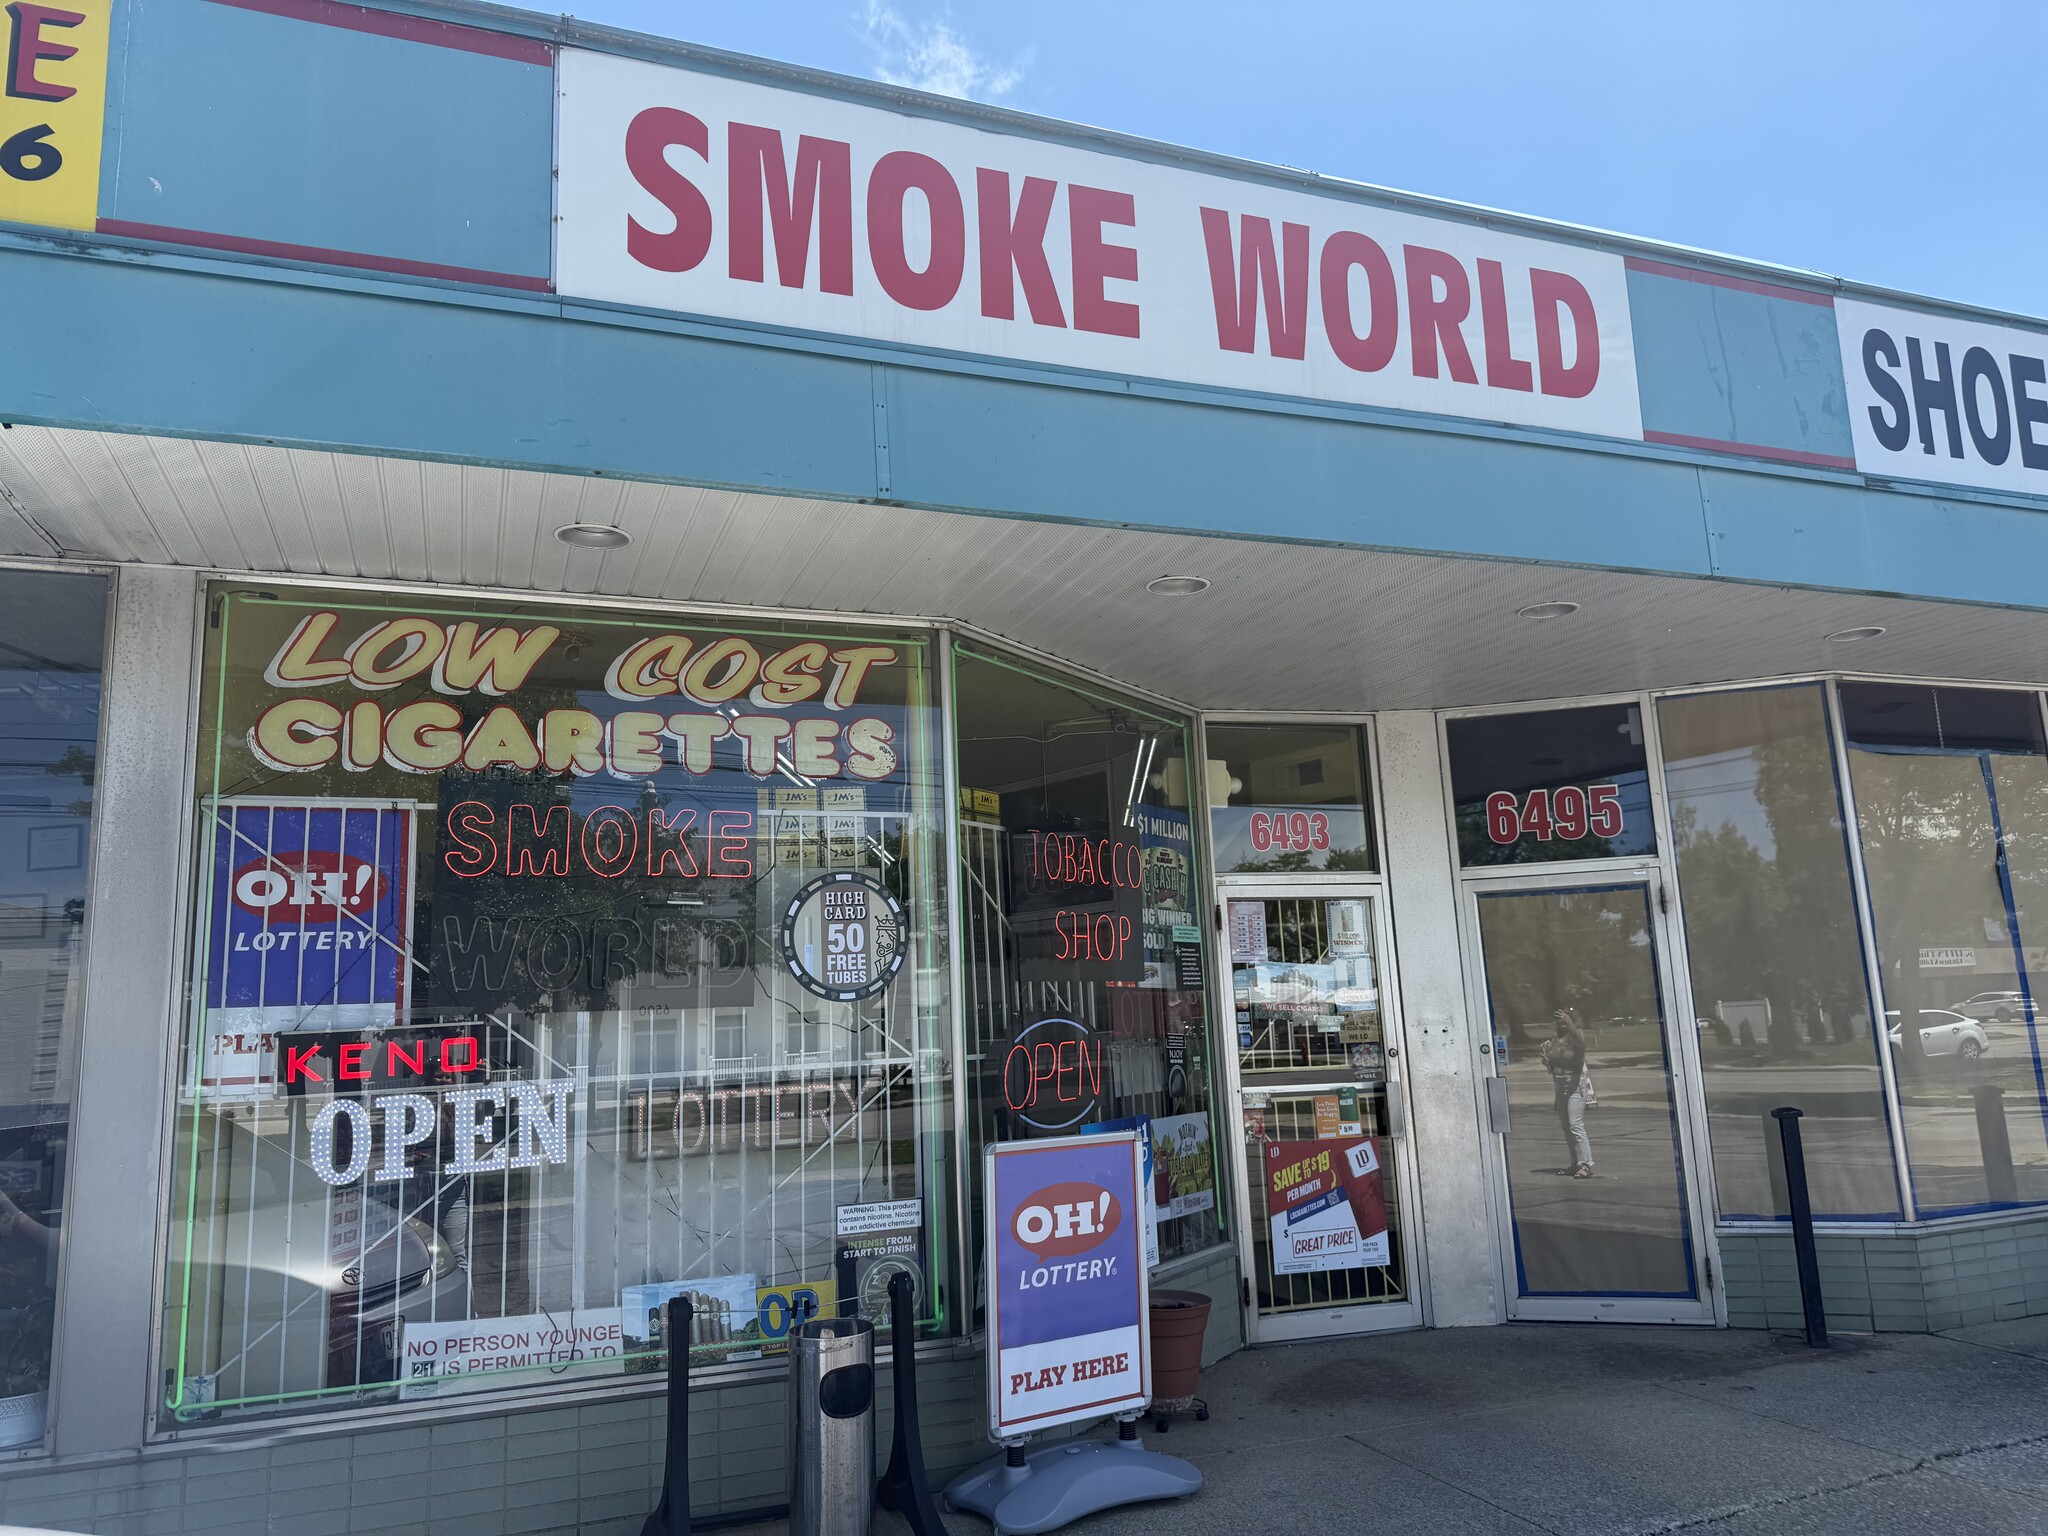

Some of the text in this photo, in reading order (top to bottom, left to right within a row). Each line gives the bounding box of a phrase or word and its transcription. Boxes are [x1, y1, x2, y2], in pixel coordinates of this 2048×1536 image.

[5, 1, 87, 103] E
[0, 123, 63, 182] 6
[625, 106, 1600, 399] SMOKE WORLD
[1862, 328, 2048, 471] SHOE
[264, 609, 898, 711] LOW COST
[247, 697, 897, 784] CIGARETTES
[1137, 813, 1189, 842] $1 MILLION
[1486, 784, 1623, 844] 6495
[445, 801, 753, 878] SMOKE
[1250, 811, 1331, 852] 6493
[1027, 829, 1142, 888] TOBACCO
[236, 864, 372, 907] OH!
[825, 891, 865, 906] HIGH
[825, 906, 866, 920] CARD
[1157, 909, 1192, 927] WINNER
[234, 931, 373, 951] LOTTERY
[827, 923, 865, 953] 50
[1055, 910, 1131, 961] SHOP
[443, 916, 750, 992] WORLD
[827, 954, 867, 970] FREE
[827, 971, 867, 984] TUBES
[214, 1034, 275, 1056] PLA
[287, 1036, 478, 1084] KENO
[1004, 1039, 1100, 1110] OPEN
[638, 1079, 873, 1156] LOTTERY
[310, 1082, 574, 1186] OPEN
[1302, 1158, 1311, 1170] UP
[1303, 1168, 1312, 1180] TO
[1355, 1149, 1370, 1168] LD
[1273, 1162, 1302, 1192] SAVE
[1286, 1178, 1322, 1203] PER MONTH
[839, 1210, 920, 1224] contains nicotine. Nicotine
[842, 1202, 917, 1215] WARNING: This product
[1016, 1190, 1111, 1244] OH!
[858, 1221, 887, 1230] addictive
[887, 1219, 917, 1228] chemical.
[1283, 1229, 1289, 1238] $
[843, 1243, 916, 1259] START TO FINISH
[847, 1235, 912, 1250] INTENSE FROM
[1294, 1230, 1354, 1255] GREAT PRICE
[407, 1340, 438, 1357] NO
[444, 1332, 530, 1355] PERSON
[536, 1324, 624, 1345] YOUNGE
[413, 1363, 434, 1379] 21
[442, 1360, 461, 1376] IS
[589, 1345, 616, 1360] TO
[1010, 1352, 1129, 1395] PLAY HERE
